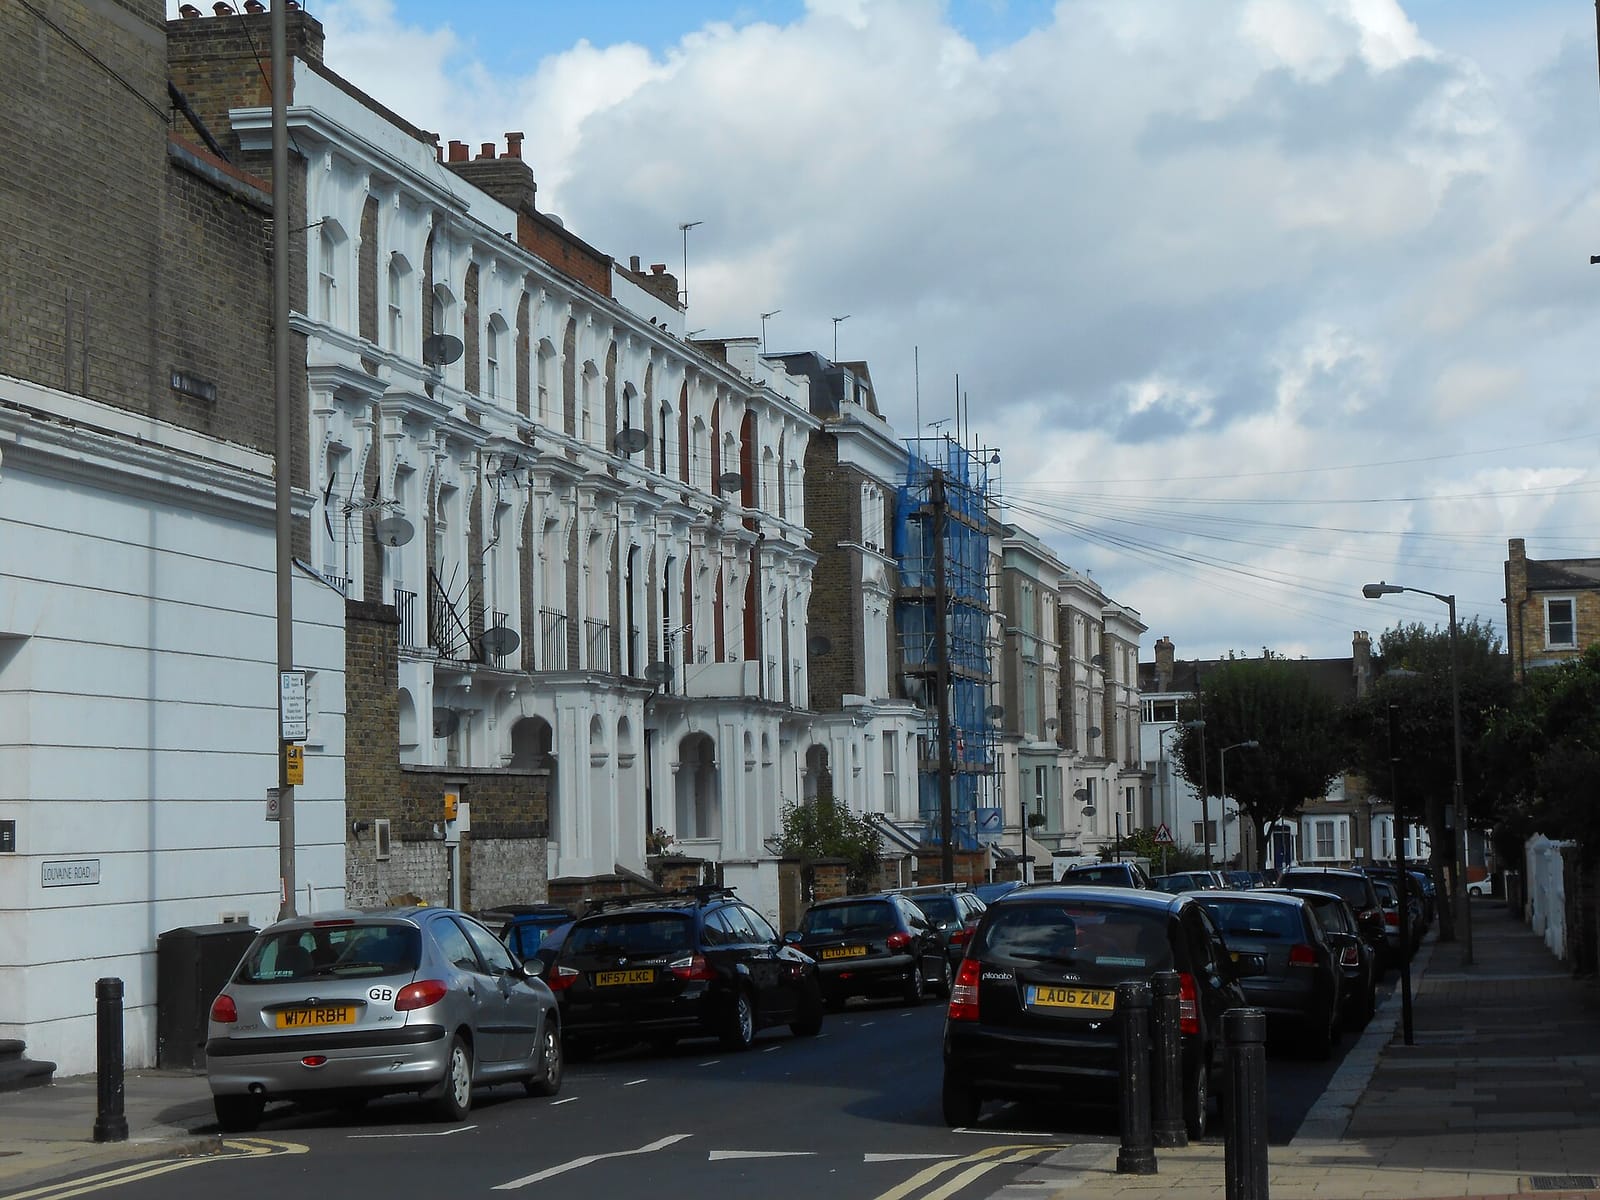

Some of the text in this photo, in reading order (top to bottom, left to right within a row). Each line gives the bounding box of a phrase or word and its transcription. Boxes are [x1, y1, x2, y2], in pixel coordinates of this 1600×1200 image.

[43, 867, 73, 881] LOUVAINE
[74, 866, 91, 879] ROAD
[628, 970, 650, 982] LKC
[369, 988, 392, 1001] GB
[1036, 987, 1111, 1007] LA06 ZWZ
[284, 1007, 347, 1026] W171 RBH
